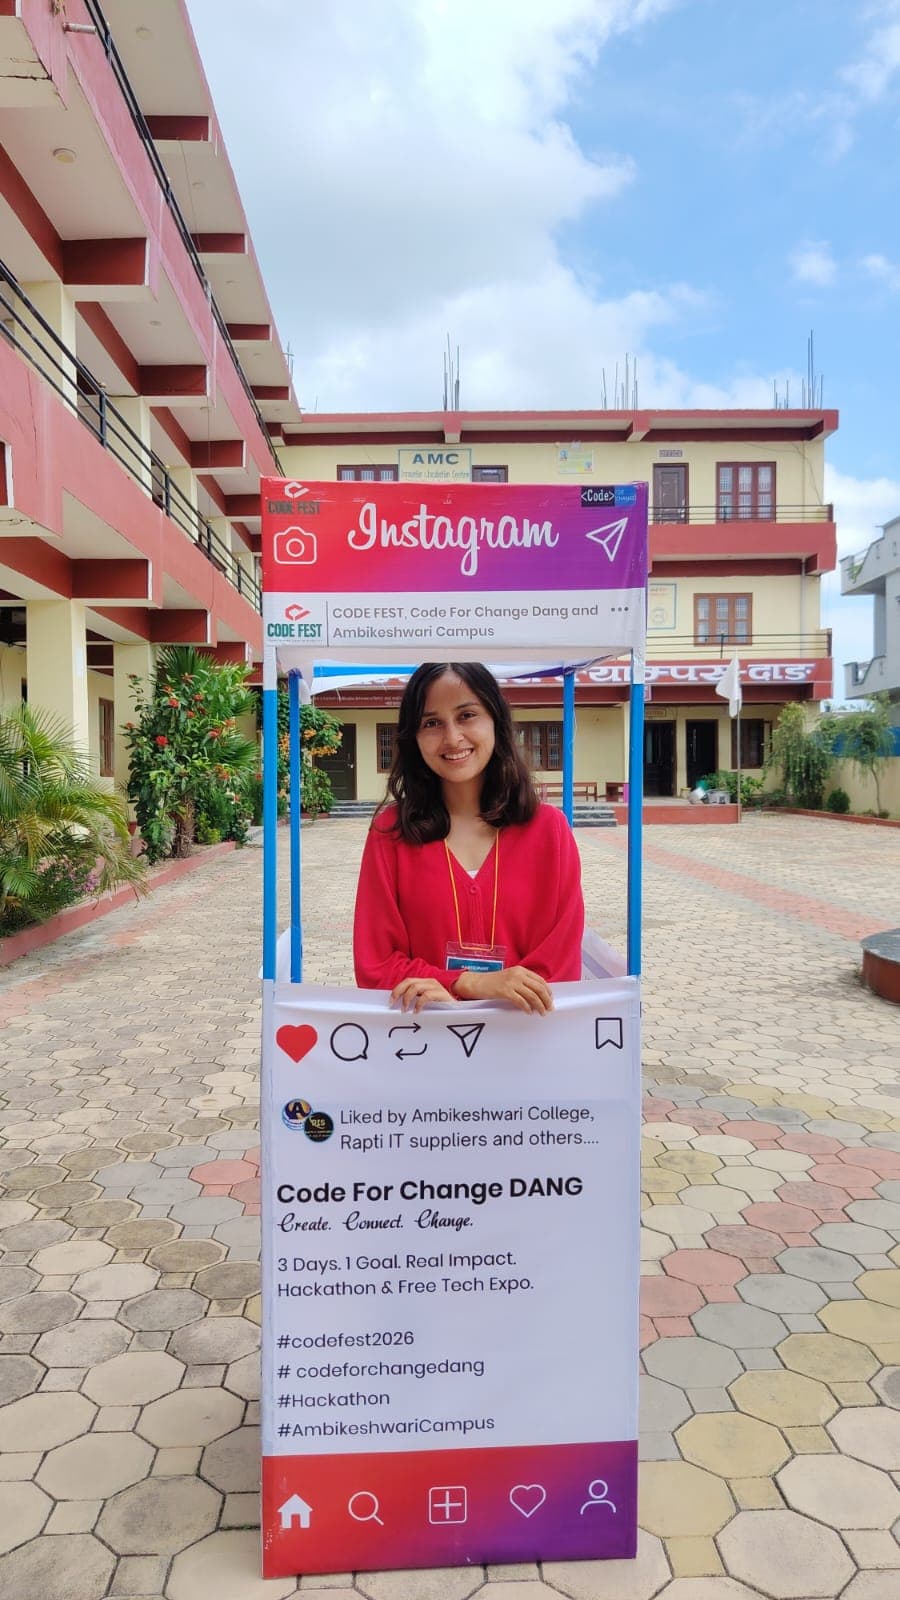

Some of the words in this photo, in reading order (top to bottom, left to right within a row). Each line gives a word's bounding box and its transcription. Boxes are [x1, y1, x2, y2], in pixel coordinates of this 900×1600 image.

[412, 453, 459, 465] AMC
[347, 502, 560, 576] Instagram
[332, 607, 371, 619] CODE
[373, 607, 407, 620] FEST,
[410, 606, 447, 618] Code
[449, 606, 472, 618] For
[474, 605, 529, 621] Change
[532, 605, 569, 620] Dang
[571, 604, 599, 616] and
[267, 623, 295, 638] CODE
[297, 623, 323, 638] FEST
[332, 625, 433, 639] Ambikeshwari
[435, 626, 495, 640] Campus
[340, 1108, 383, 1125] Liked
[387, 1109, 407, 1127] by
[411, 1106, 523, 1123] Ambikeshwari
[527, 1105, 595, 1123] College,
[340, 1133, 384, 1153] Rapti
[389, 1133, 405, 1149] IT
[409, 1132, 488, 1152] suppliers
[492, 1130, 524, 1147] and
[528, 1129, 599, 1146] others....
[276, 1182, 347, 1204] Code
[353, 1182, 394, 1202] For
[399, 1179, 504, 1206] Change
[509, 1176, 583, 1198] DANG
[276, 1212, 332, 1233] Create.
[342, 1210, 404, 1231] Connect.
[413, 1208, 473, 1232] Change.
[277, 1257, 288, 1272] 3
[293, 1257, 342, 1276] Days.
[345, 1256, 351, 1271] 1
[355, 1254, 402, 1270] Goal.
[406, 1253, 444, 1269] Real
[448, 1251, 517, 1271] Impact.
[277, 1281, 376, 1297] Hackathon
[380, 1280, 394, 1295] &
[398, 1279, 437, 1294] Free
[441, 1276, 485, 1293] Tech
[489, 1276, 534, 1295] Expo.
[276, 1330, 415, 1349] #codefest2026
[276, 1364, 292, 1379] #
[296, 1358, 485, 1379] codeforchangedang
[276, 1391, 390, 1409] #Hackathon
[277, 1418, 495, 1438] #AmbikeshwariCampus
